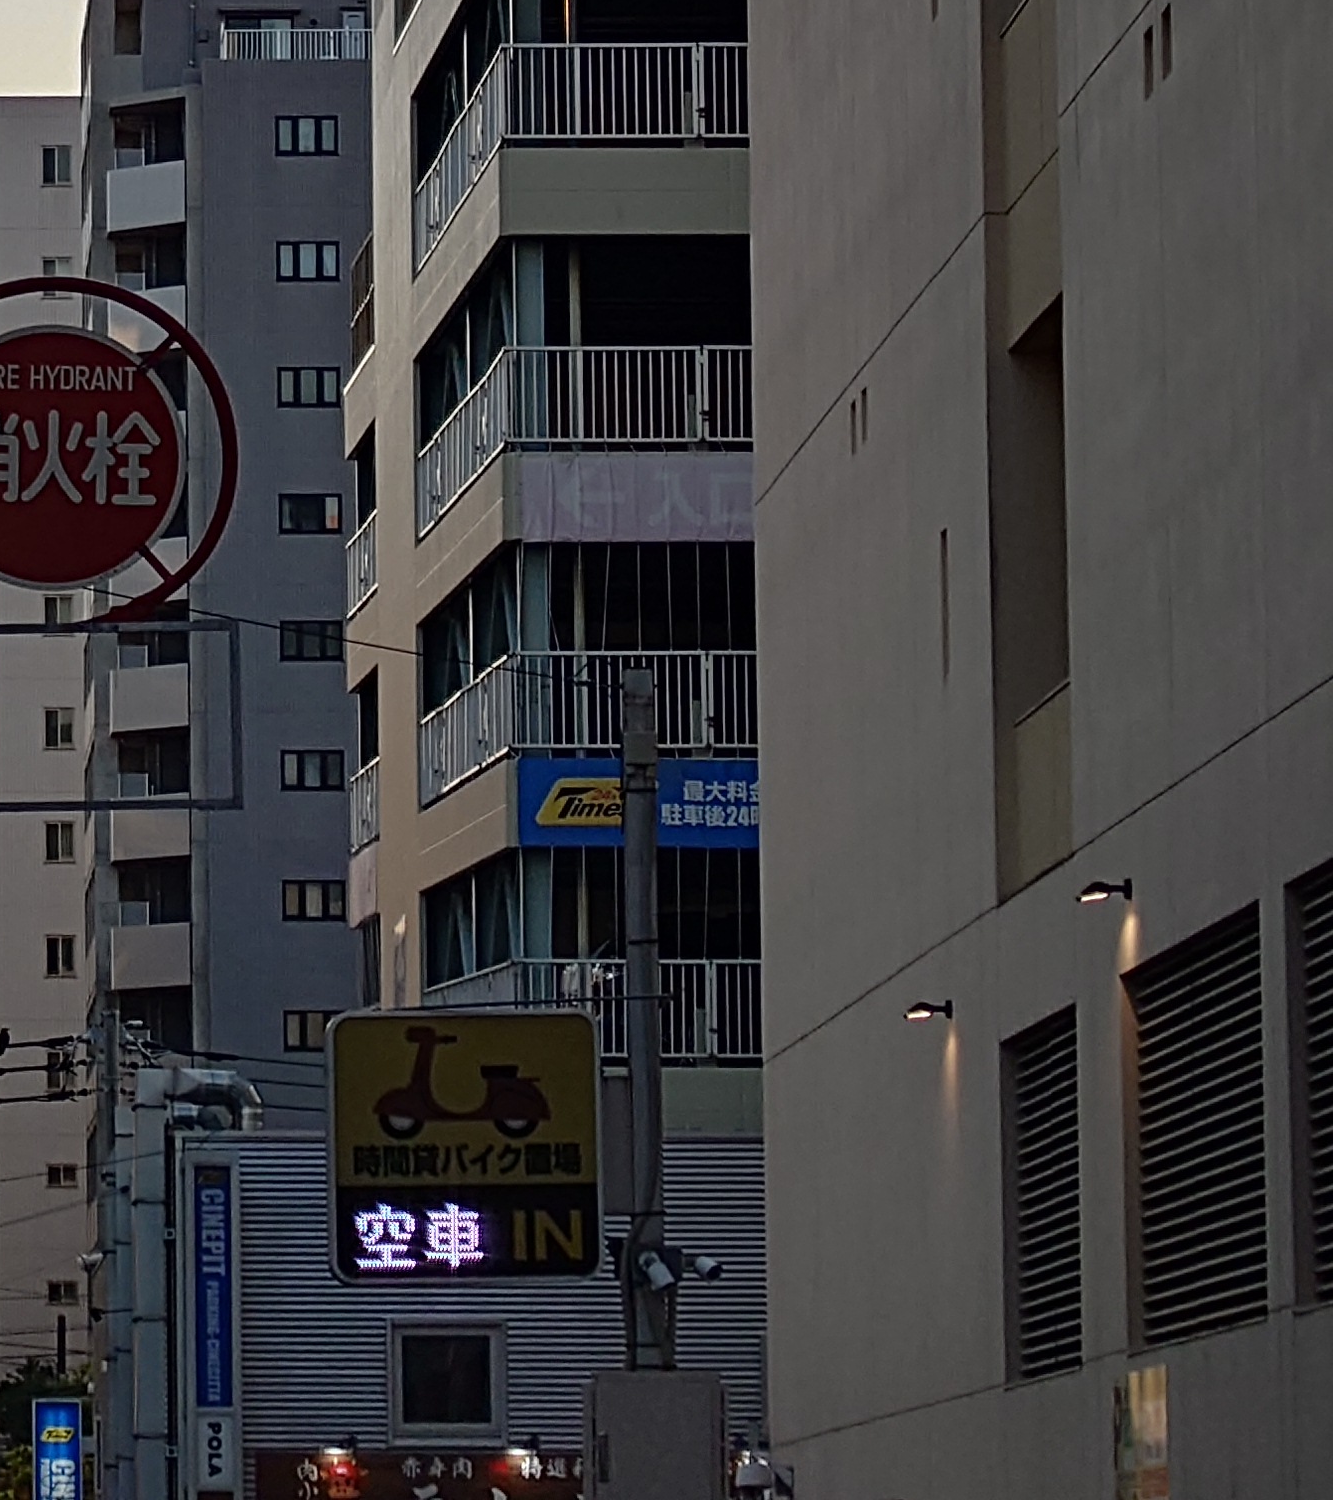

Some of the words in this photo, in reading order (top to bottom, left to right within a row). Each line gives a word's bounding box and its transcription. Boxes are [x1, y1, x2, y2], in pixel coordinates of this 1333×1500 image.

[30, 365, 137, 392] HYDRANT
[553, 786, 623, 819] Time
[353, 1143, 582, 1178] 時間貸バイク置場
[201, 1188, 226, 1277] CINEPIT
[353, 1201, 485, 1271] 空車
[512, 1209, 582, 1262] IN
[207, 1422, 223, 1478] POLA
